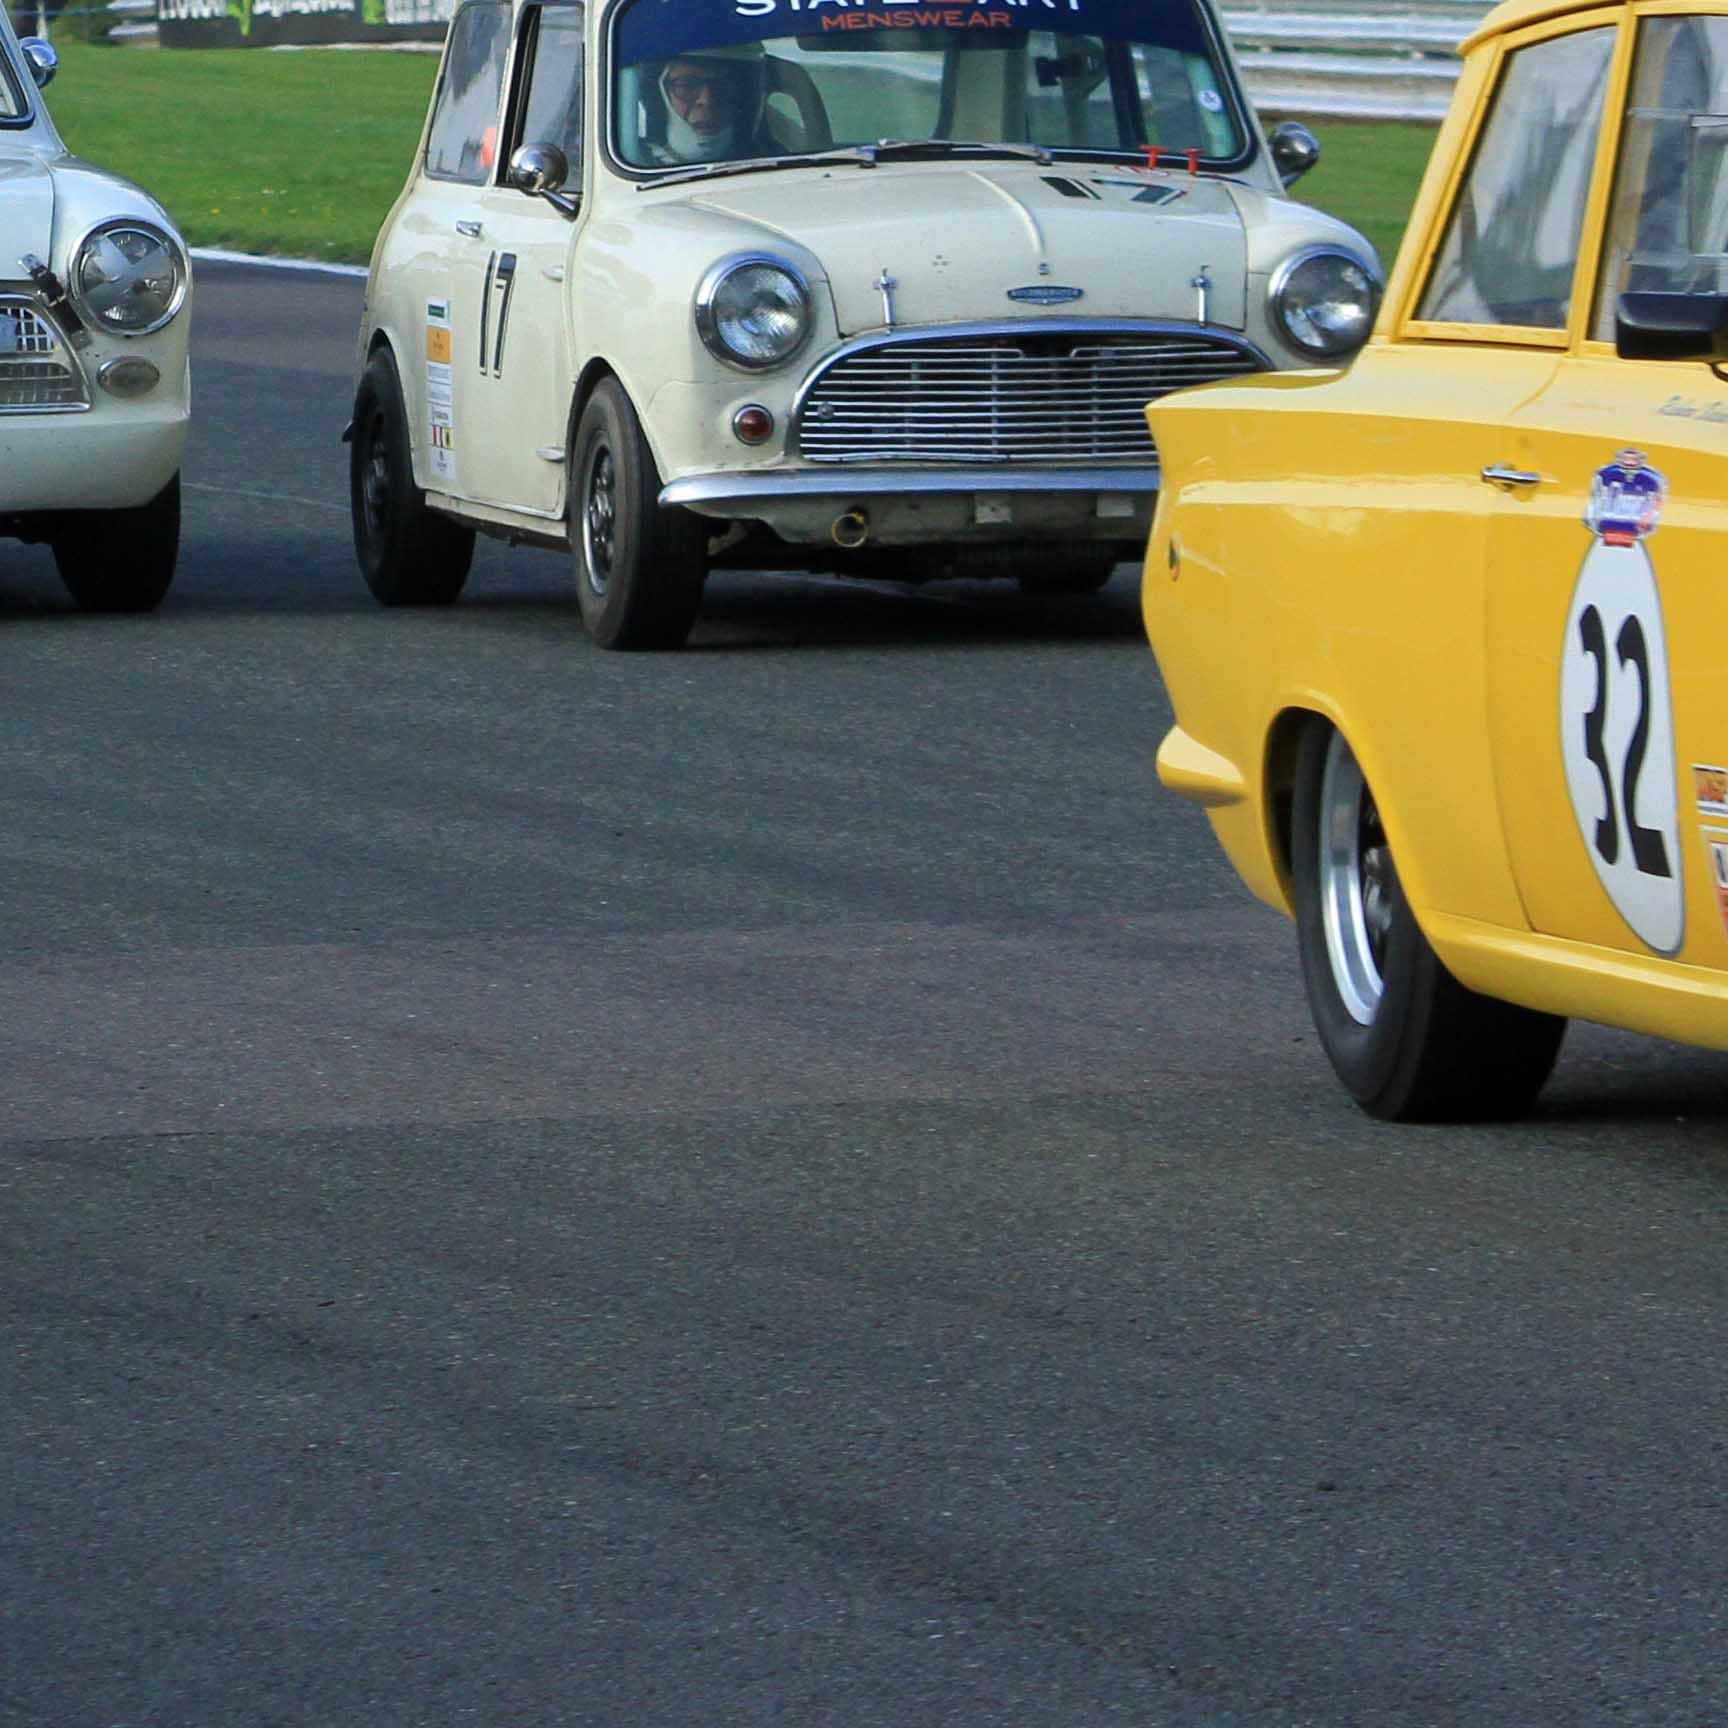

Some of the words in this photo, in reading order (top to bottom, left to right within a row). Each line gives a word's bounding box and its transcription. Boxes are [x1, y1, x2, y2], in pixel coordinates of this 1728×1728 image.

[821, 10, 1011, 31] MENSWEAR
[1039, 176, 1188, 205] 17
[480, 251, 517, 379] 17
[1579, 604, 1672, 878] 32
